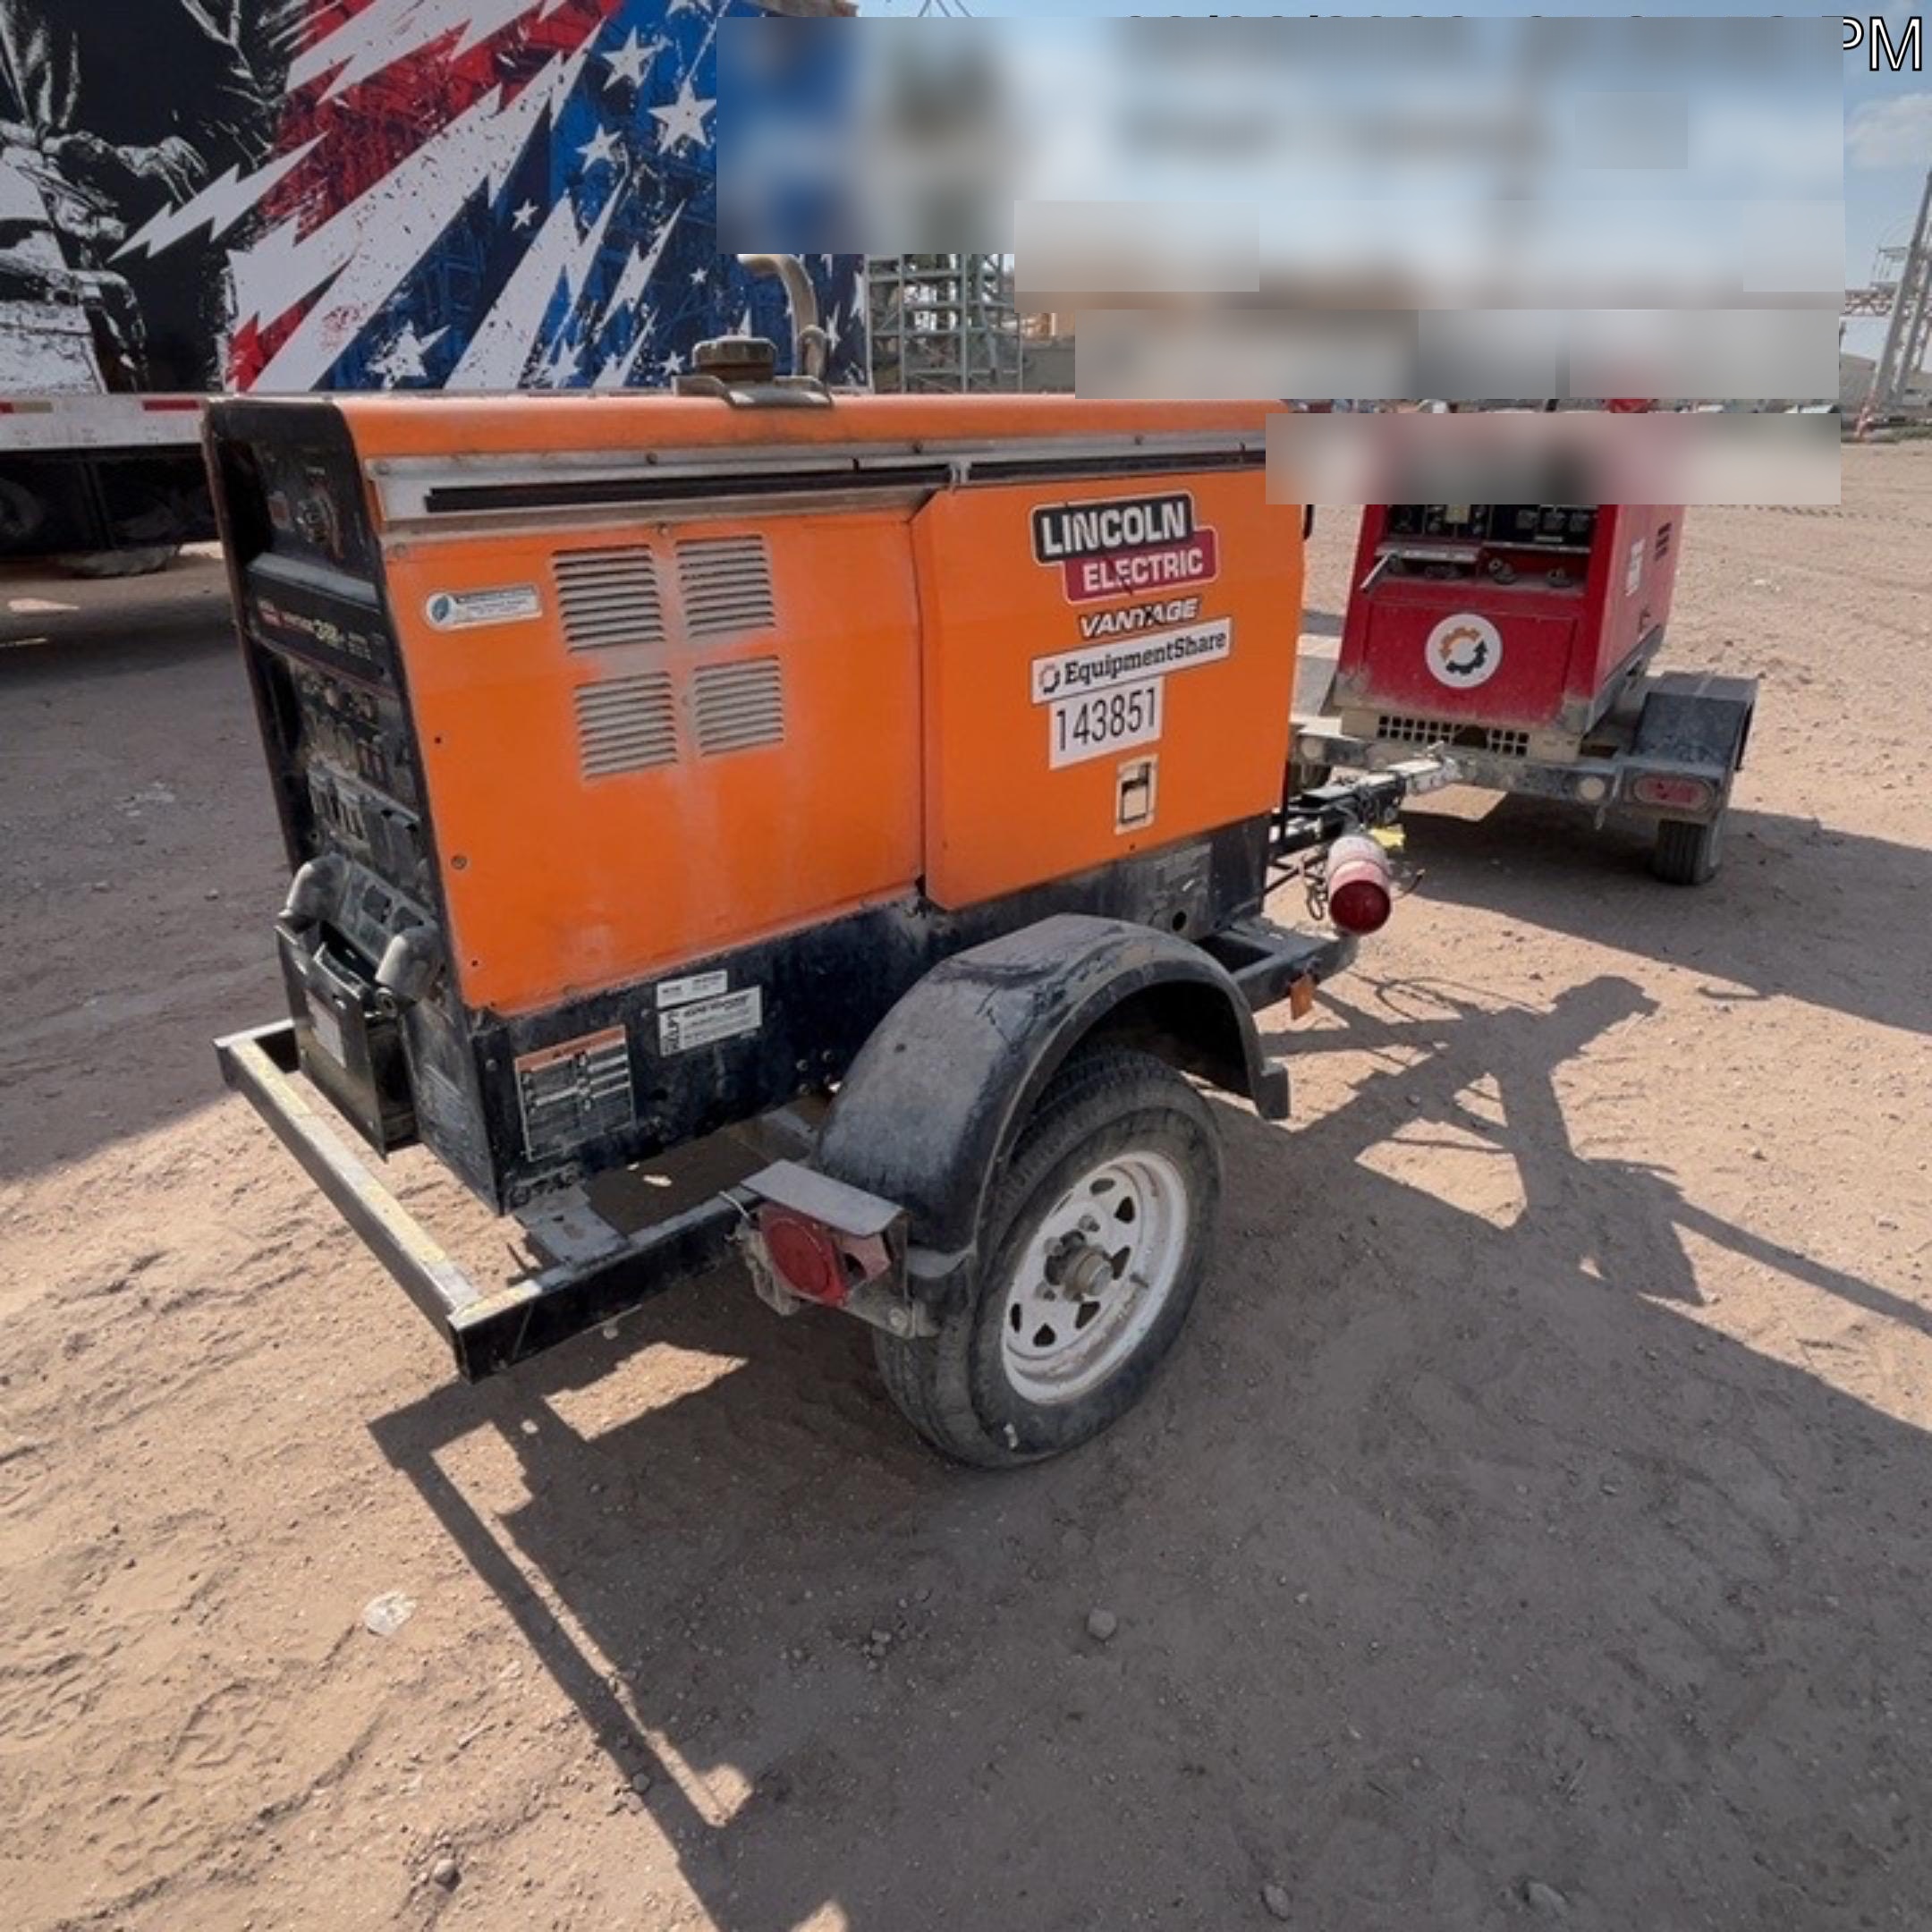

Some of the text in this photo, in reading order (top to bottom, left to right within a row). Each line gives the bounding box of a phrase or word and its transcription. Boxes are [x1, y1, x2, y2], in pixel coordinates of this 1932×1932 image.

[1040, 501, 1187, 555] LINCOLN
[1082, 548, 1204, 592] ELECTRIC
[1080, 597, 1199, 638] VANTAGE
[1064, 631, 1227, 685] EquipmentShare
[1056, 686, 1156, 751] 143851
